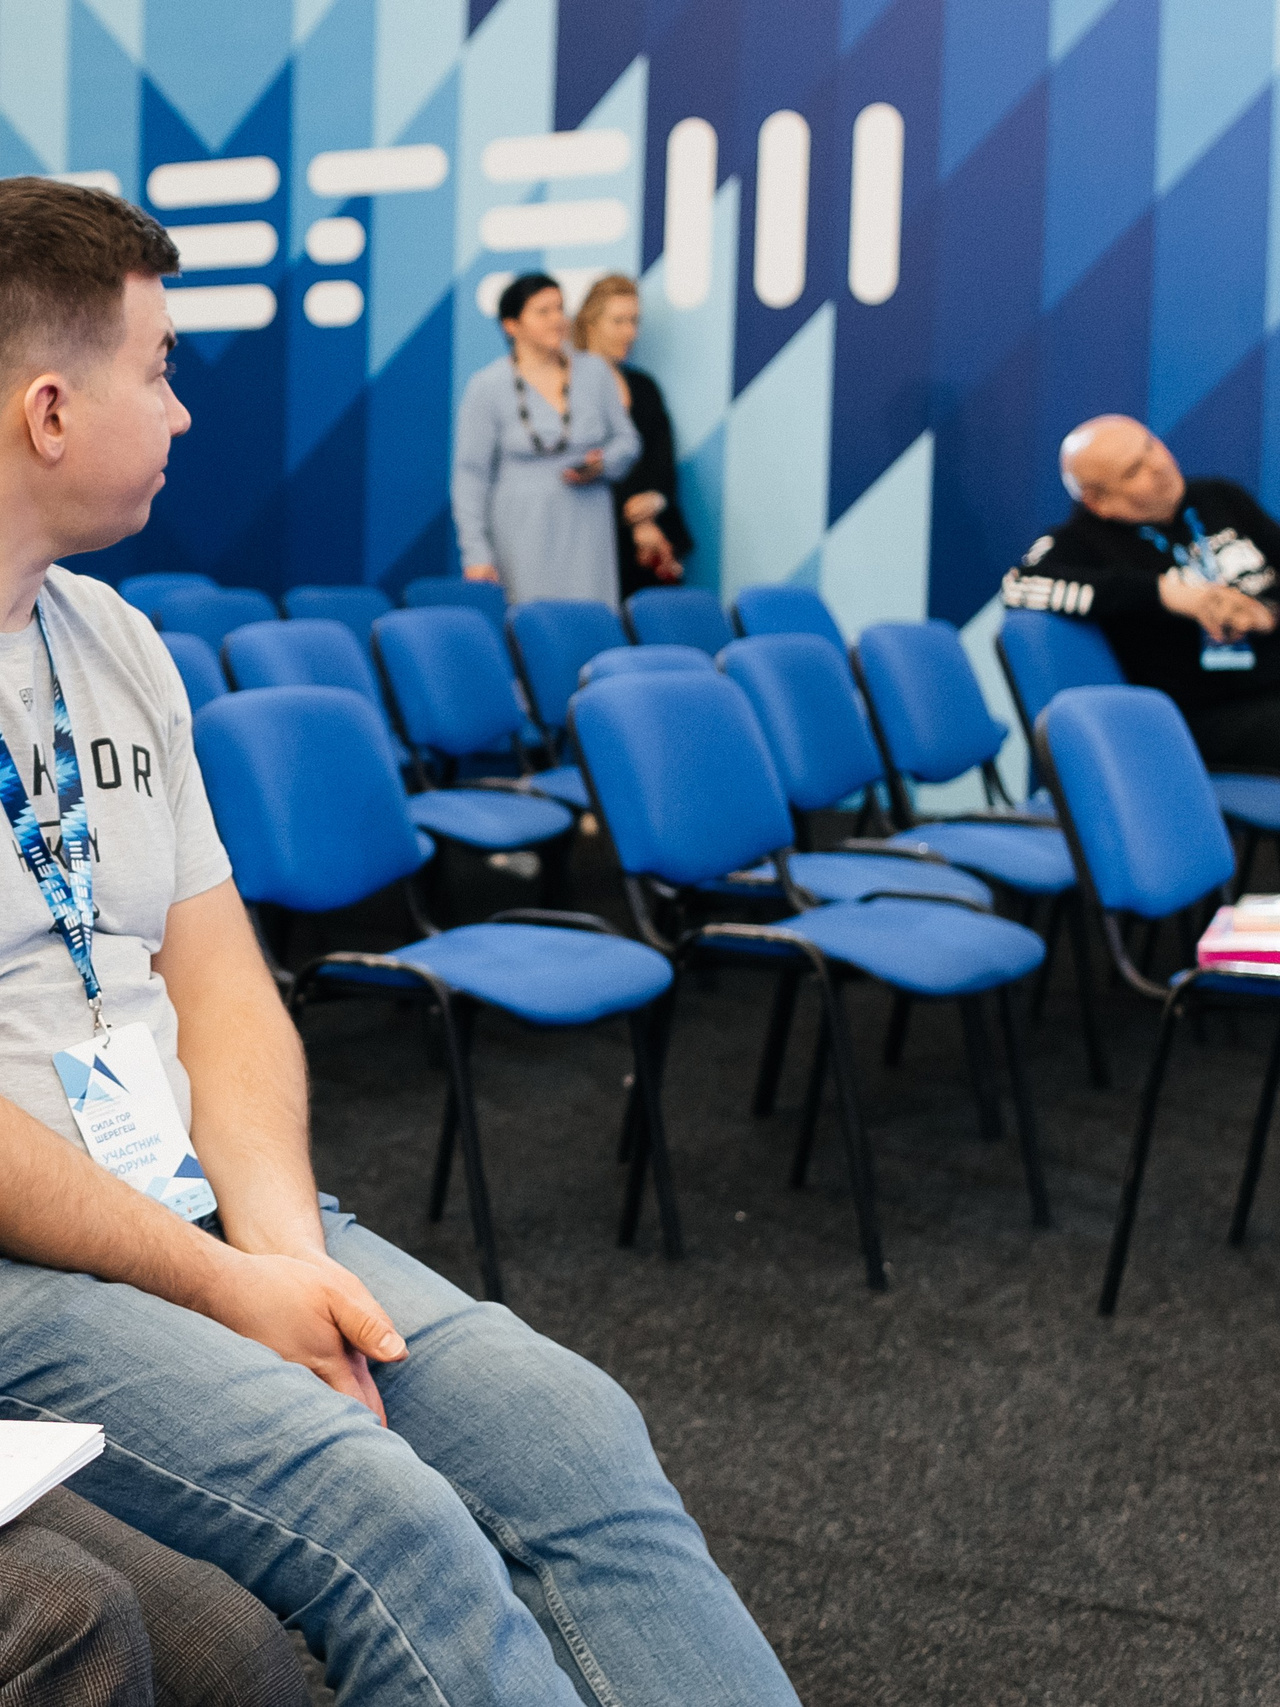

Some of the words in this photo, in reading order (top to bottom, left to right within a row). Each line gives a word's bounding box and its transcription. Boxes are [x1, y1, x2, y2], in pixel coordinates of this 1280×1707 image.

[90, 1119, 115, 1133] СИЛА
[115, 1111, 131, 1126] ГОР
[94, 1123, 136, 1144] ШЕРЕГЕШ
[101, 1133, 162, 1164] УЧАСТНИК
